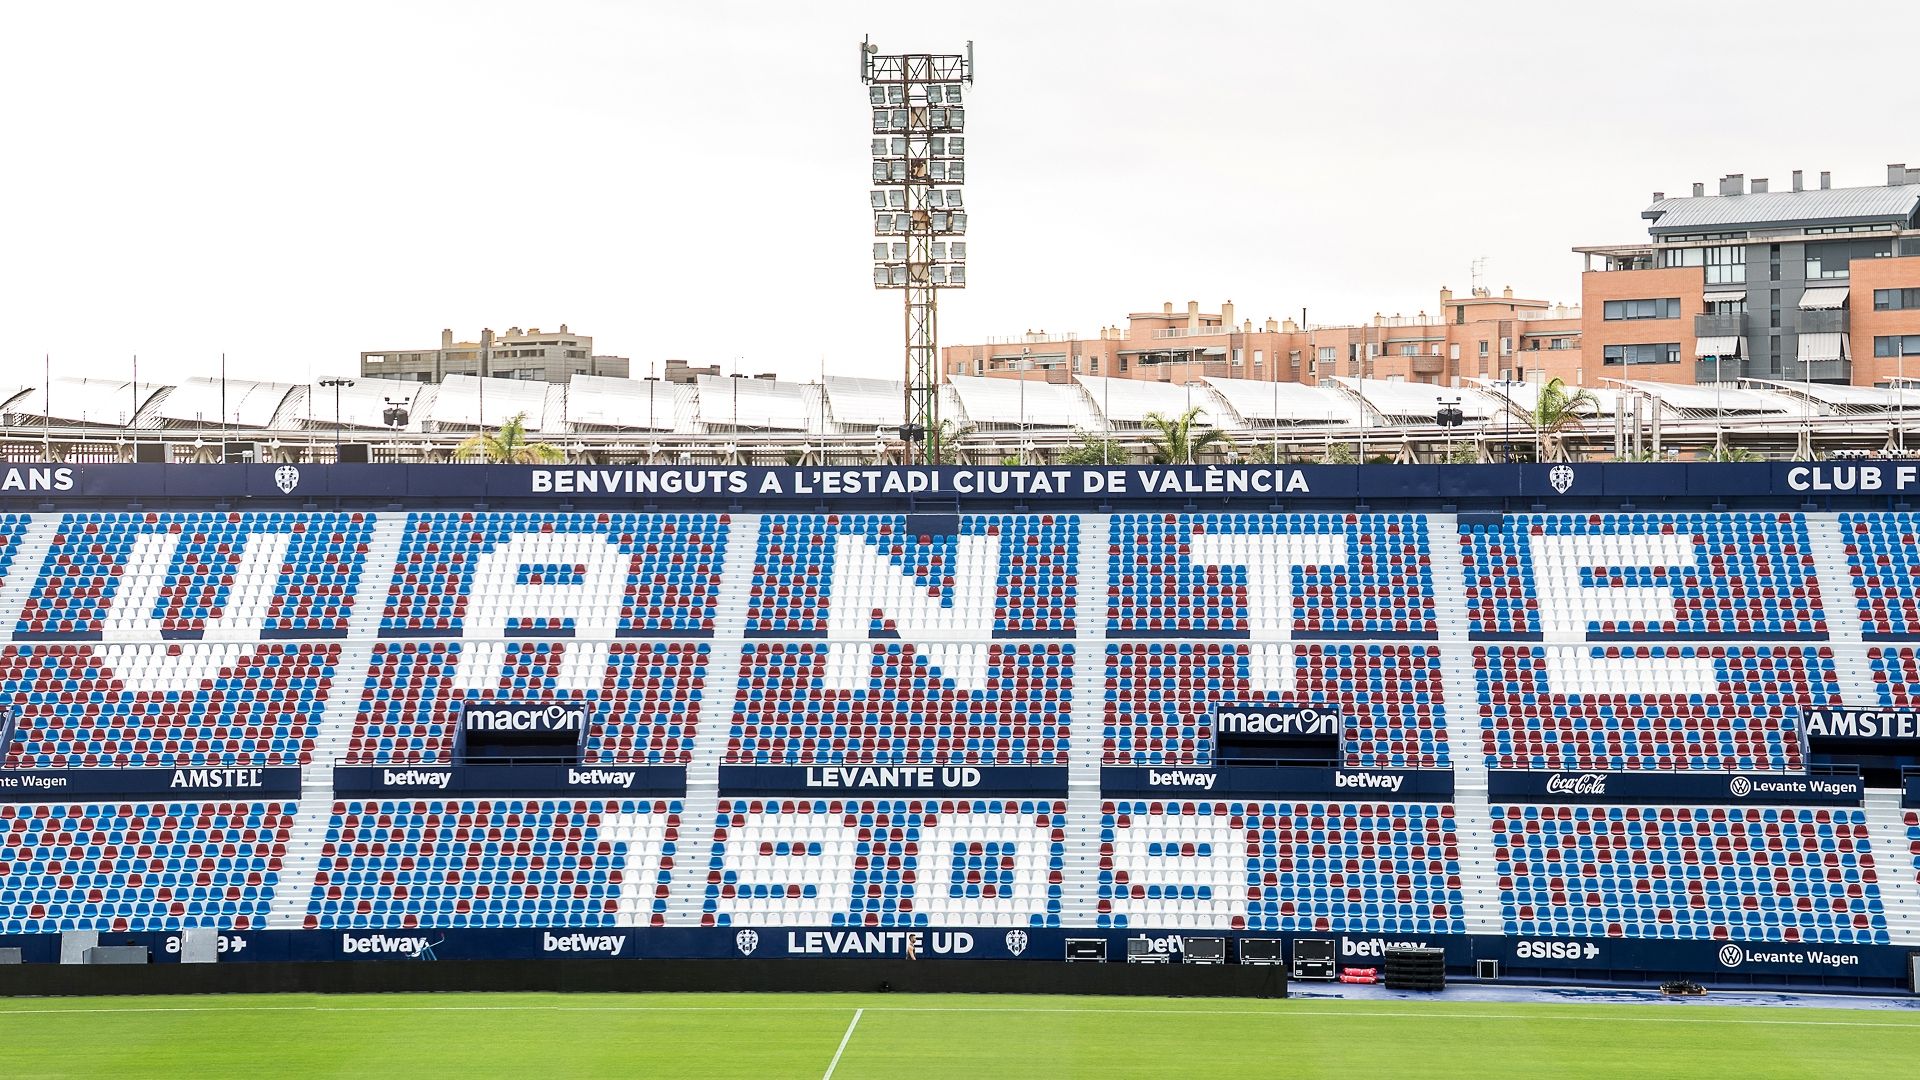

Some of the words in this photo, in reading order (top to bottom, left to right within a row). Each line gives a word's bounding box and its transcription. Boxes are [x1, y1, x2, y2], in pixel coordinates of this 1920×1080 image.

[1, 467, 74, 491] ANS
[531, 468, 749, 493] BENVINGUTS
[759, 469, 787, 493] A
[794, 467, 940, 493] L'ESTADI
[951, 467, 1073, 492] CIUTAT
[1082, 468, 1127, 492] DE
[1137, 463, 1311, 493] VALÈNCIA
[1787, 466, 1883, 491] CLUB
[466, 705, 584, 731] macron
[1218, 708, 1338, 734] macron
[1806, 711, 1920, 737] AMSTE
[21, 775, 67, 789] Wagen
[170, 769, 263, 788] AMSTEL
[383, 769, 452, 789] betway
[568, 769, 636, 789] betway
[806, 766, 934, 788] LEVANTE
[942, 766, 982, 788] UD
[1149, 770, 1217, 790] betway
[1335, 770, 1404, 792] betway
[1753, 781, 1807, 793] Levante
[1809, 780, 1857, 795] Wagen
[343, 933, 427, 958] betway
[543, 932, 626, 957] betway
[788, 931, 925, 954] LEVANTE
[932, 931, 975, 954] UD
[1516, 940, 1581, 960] asisa
[1745, 950, 1804, 965] Levante
[1806, 950, 1859, 967] Wagen
